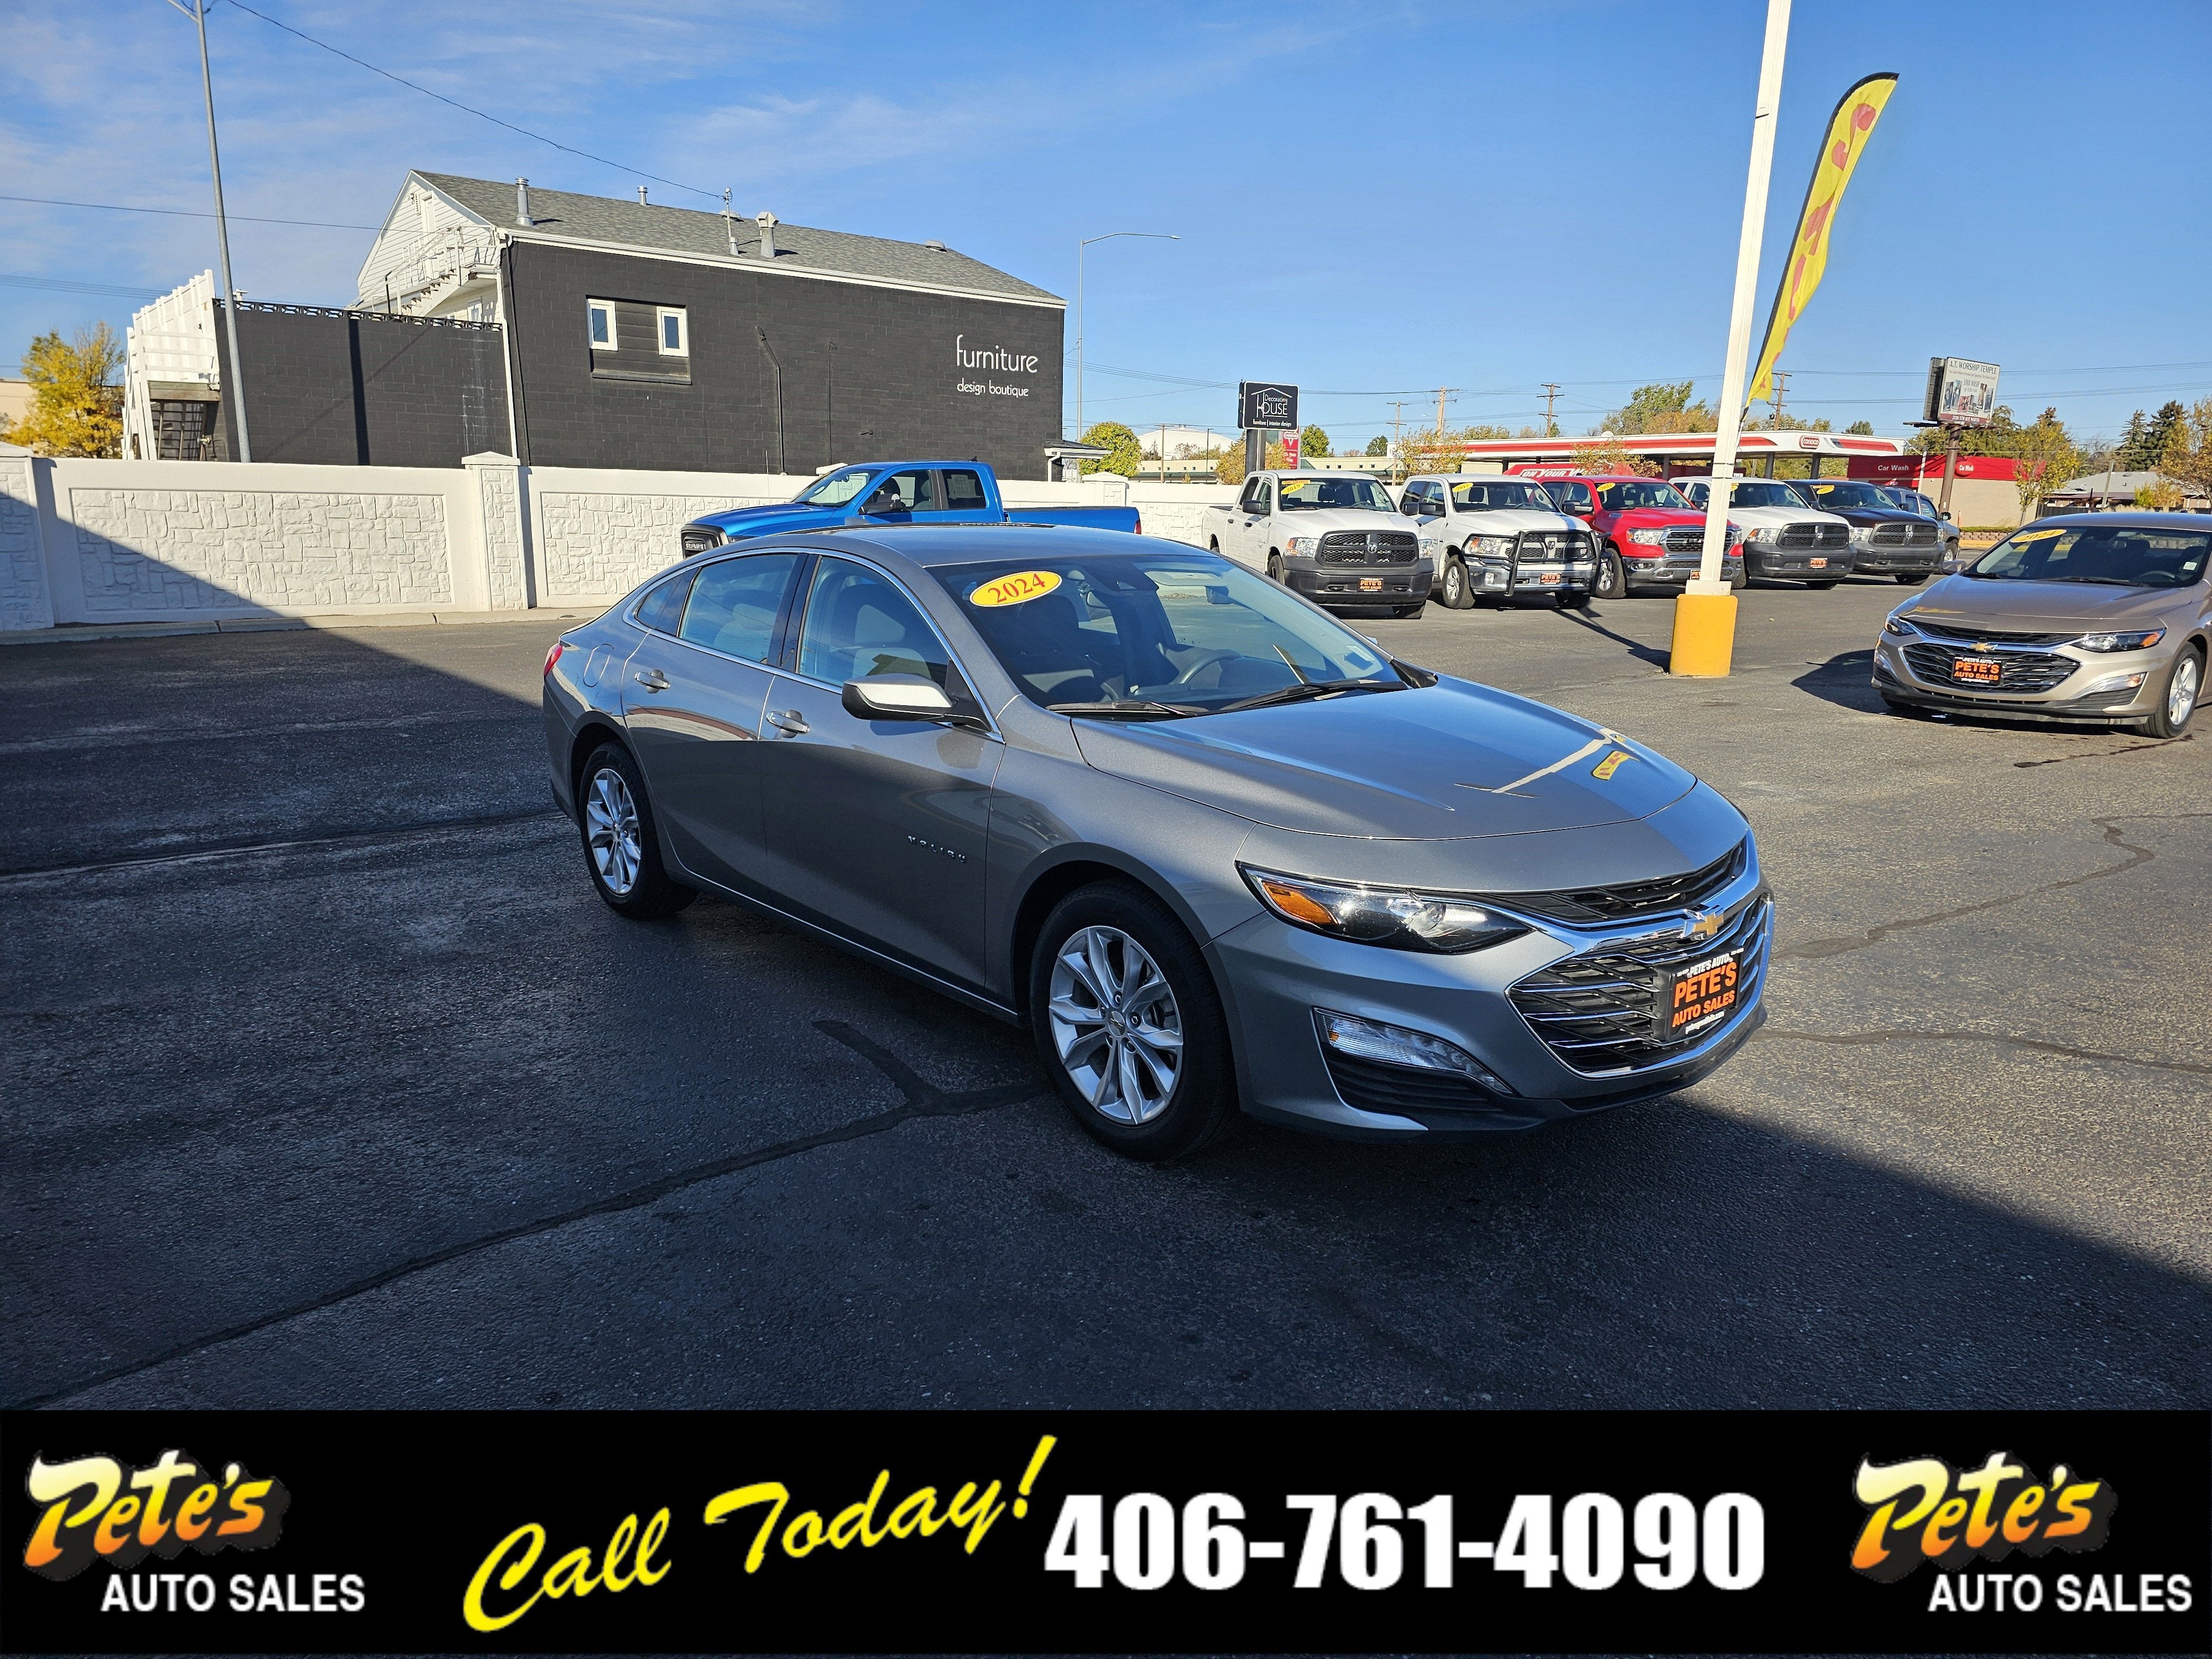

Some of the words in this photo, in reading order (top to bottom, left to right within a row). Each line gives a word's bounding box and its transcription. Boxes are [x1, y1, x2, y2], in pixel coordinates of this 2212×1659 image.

[957, 334, 1038, 373] furniture
[1959, 361, 1980, 371] WORSHIP
[1981, 365, 1997, 374] TEMPLE
[957, 377, 985, 395] design
[989, 379, 1029, 398] boutique
[1265, 394, 1287, 403] Decorating
[1256, 392, 1287, 418] HOUSE
[988, 573, 1046, 603] 2024
[1955, 661, 2000, 674] PETE'S
[1689, 959, 1712, 975] PETE'S
[1712, 953, 1730, 968] AUTO
[1674, 962, 1737, 1008] PETE'S
[1672, 1004, 1701, 1027] AUTO
[1703, 990, 1735, 1014] SALES
